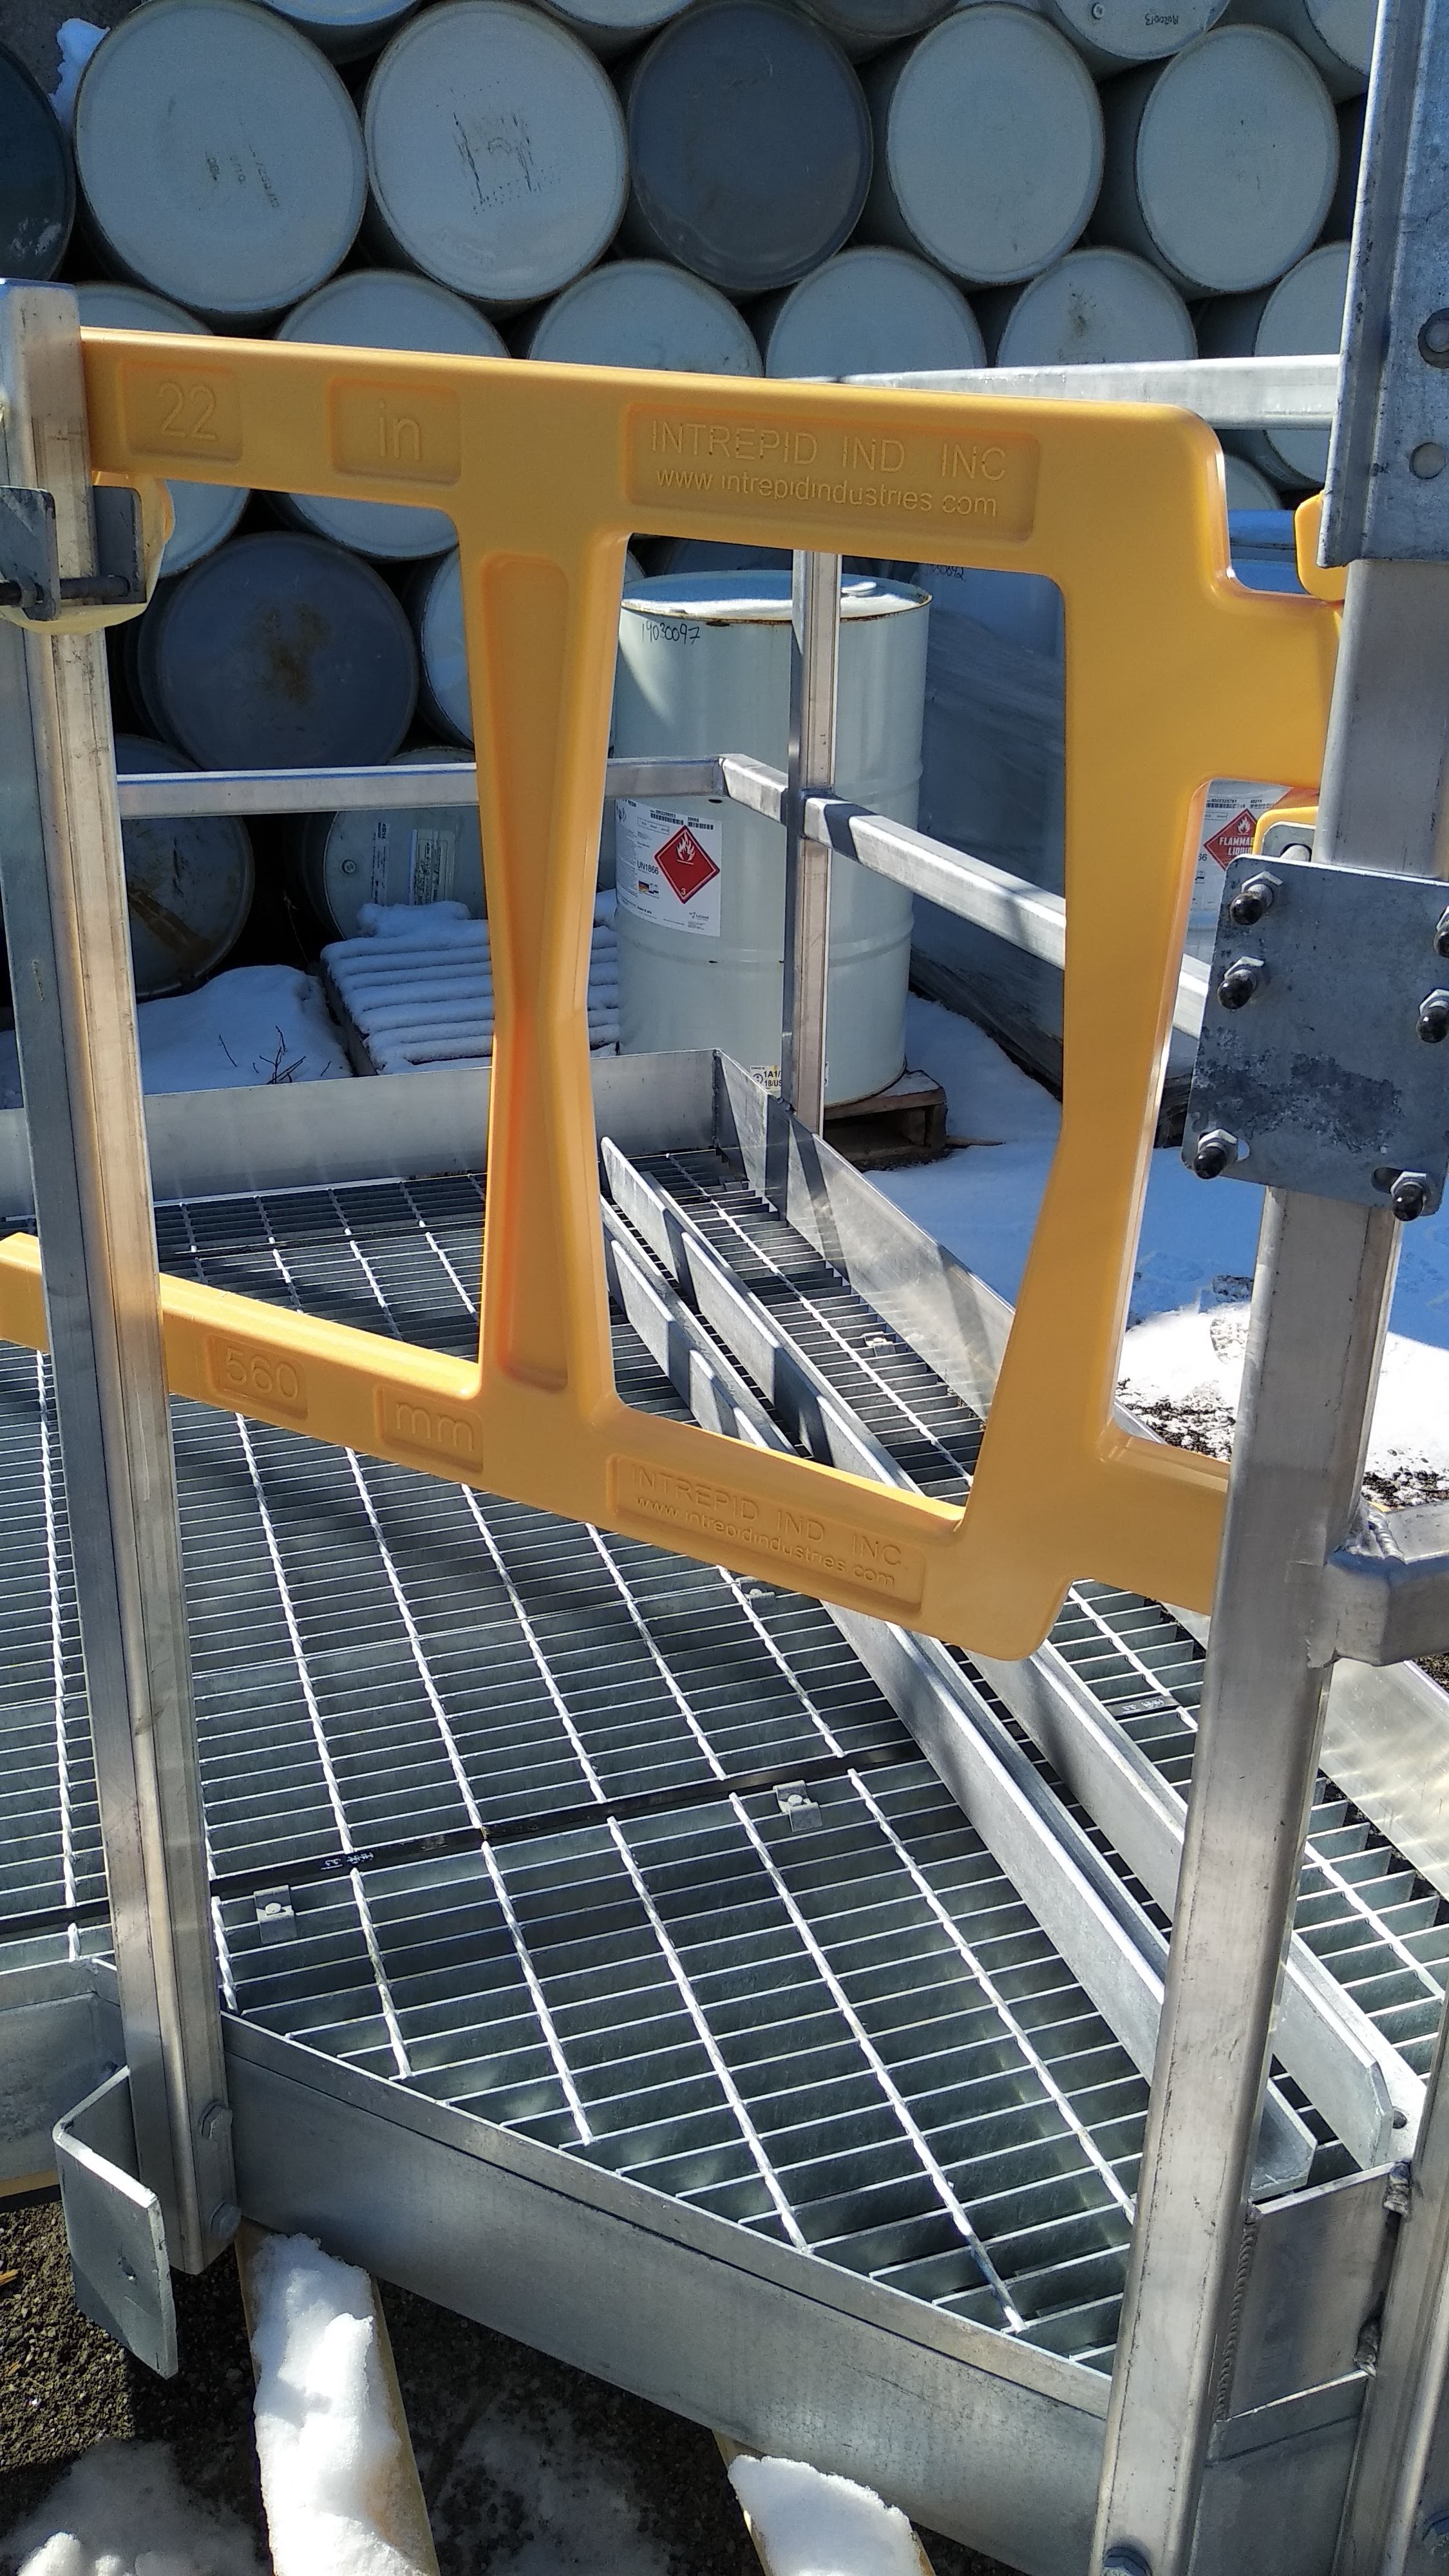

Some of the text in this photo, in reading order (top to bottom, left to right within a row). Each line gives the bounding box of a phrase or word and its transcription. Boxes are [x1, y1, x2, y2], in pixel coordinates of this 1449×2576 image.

[157, 380, 218, 442] 22
[378, 399, 422, 460] in
[651, 420, 1007, 482] INTREPID IND INC
[642, 620, 701, 645] 19030097
[636, 860, 659, 875] UN1866
[227, 1347, 299, 1400] 560
[397, 1402, 474, 1451] mm
[630, 1463, 902, 1566] INTREPID IND INC
